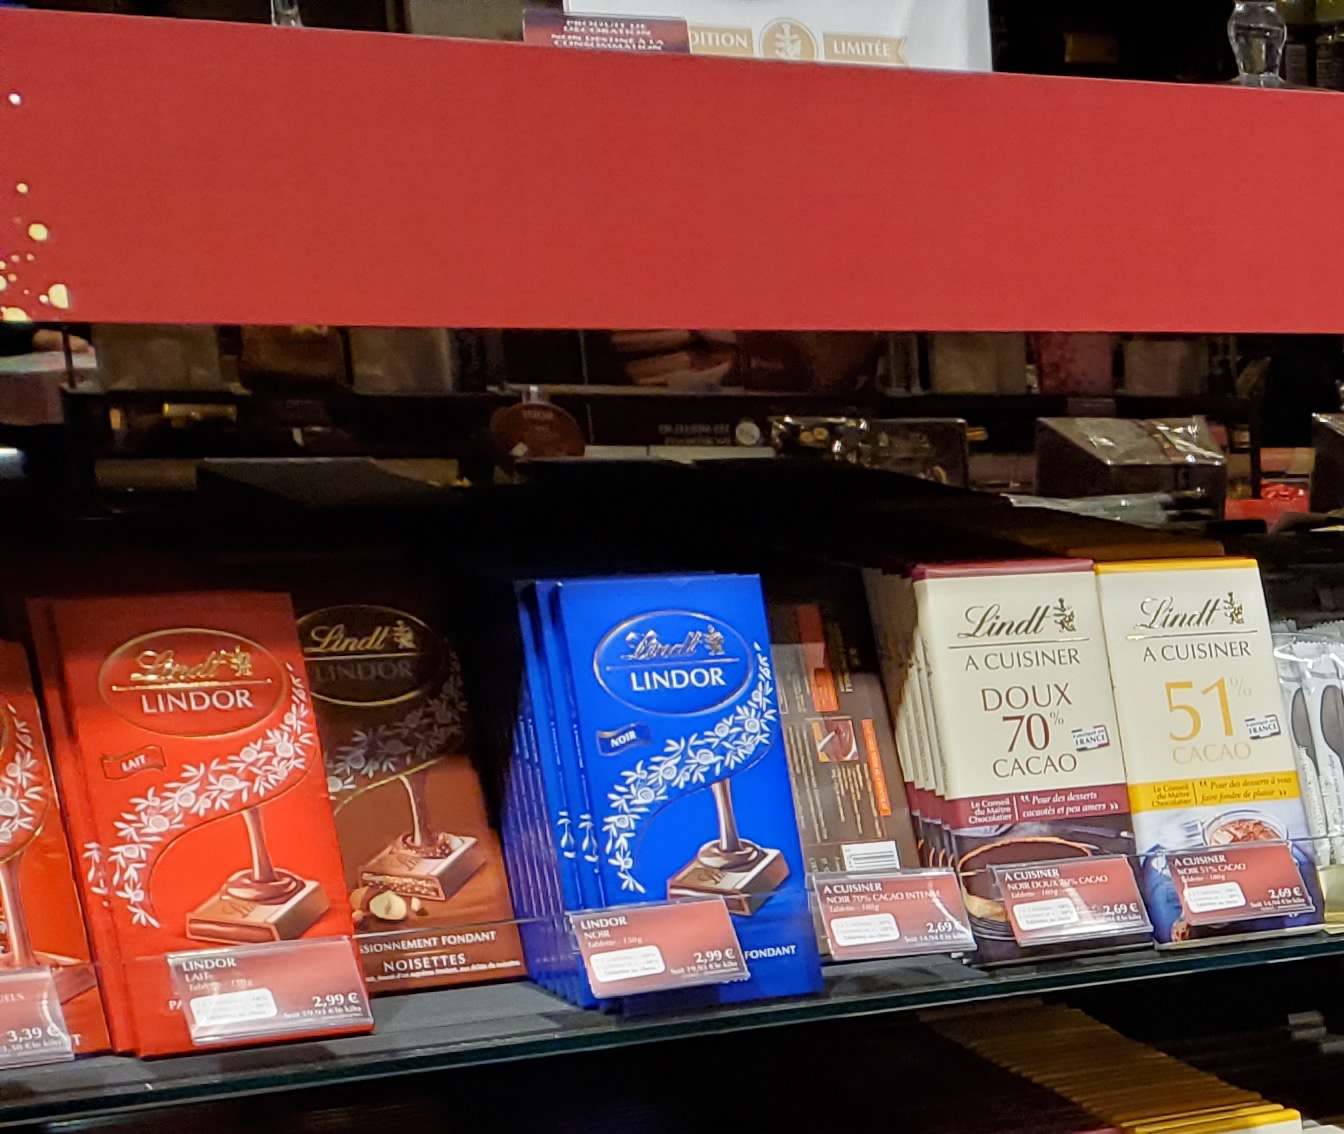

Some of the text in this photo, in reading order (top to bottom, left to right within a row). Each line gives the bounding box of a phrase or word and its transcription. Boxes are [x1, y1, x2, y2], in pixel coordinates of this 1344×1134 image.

[833, 37, 891, 57] LIMITÉE
[957, 601, 1052, 639] Lindt
[964, 647, 1081, 671] A CUISINER
[1142, 641, 1252, 663] A CUISINER
[630, 667, 727, 692] LINDOR
[140, 688, 254, 715] LINDOR
[980, 682, 1073, 713] DOUX
[610, 730, 638, 749] NOIR
[1172, 741, 1253, 766] CACAO
[120, 754, 147, 773] LAIT
[992, 752, 1078, 779] CACAO
[1173, 854, 1227, 867] A CUISINER
[823, 882, 883, 894] A CUISINER
[1268, 886, 1303, 899] 2,69 €
[825, 895, 850, 905] NOIR
[851, 894, 872, 904] 70%
[872, 892, 905, 902] CACAO
[1103, 902, 1139, 917] 2,69 €
[581, 916, 628, 930] LINDOR
[926, 922, 952, 934] 2,69
[583, 929, 612, 940] NOIR
[693, 948, 736, 964] 2,99 €
[744, 944, 797, 961] FONDANT
[181, 956, 237, 973] LINDOR
[382, 952, 467, 974] NOISETTES
[184, 971, 212, 984] LAIT
[311, 991, 360, 1009] 2,99 €
[6, 1026, 43, 1041] 3,39
